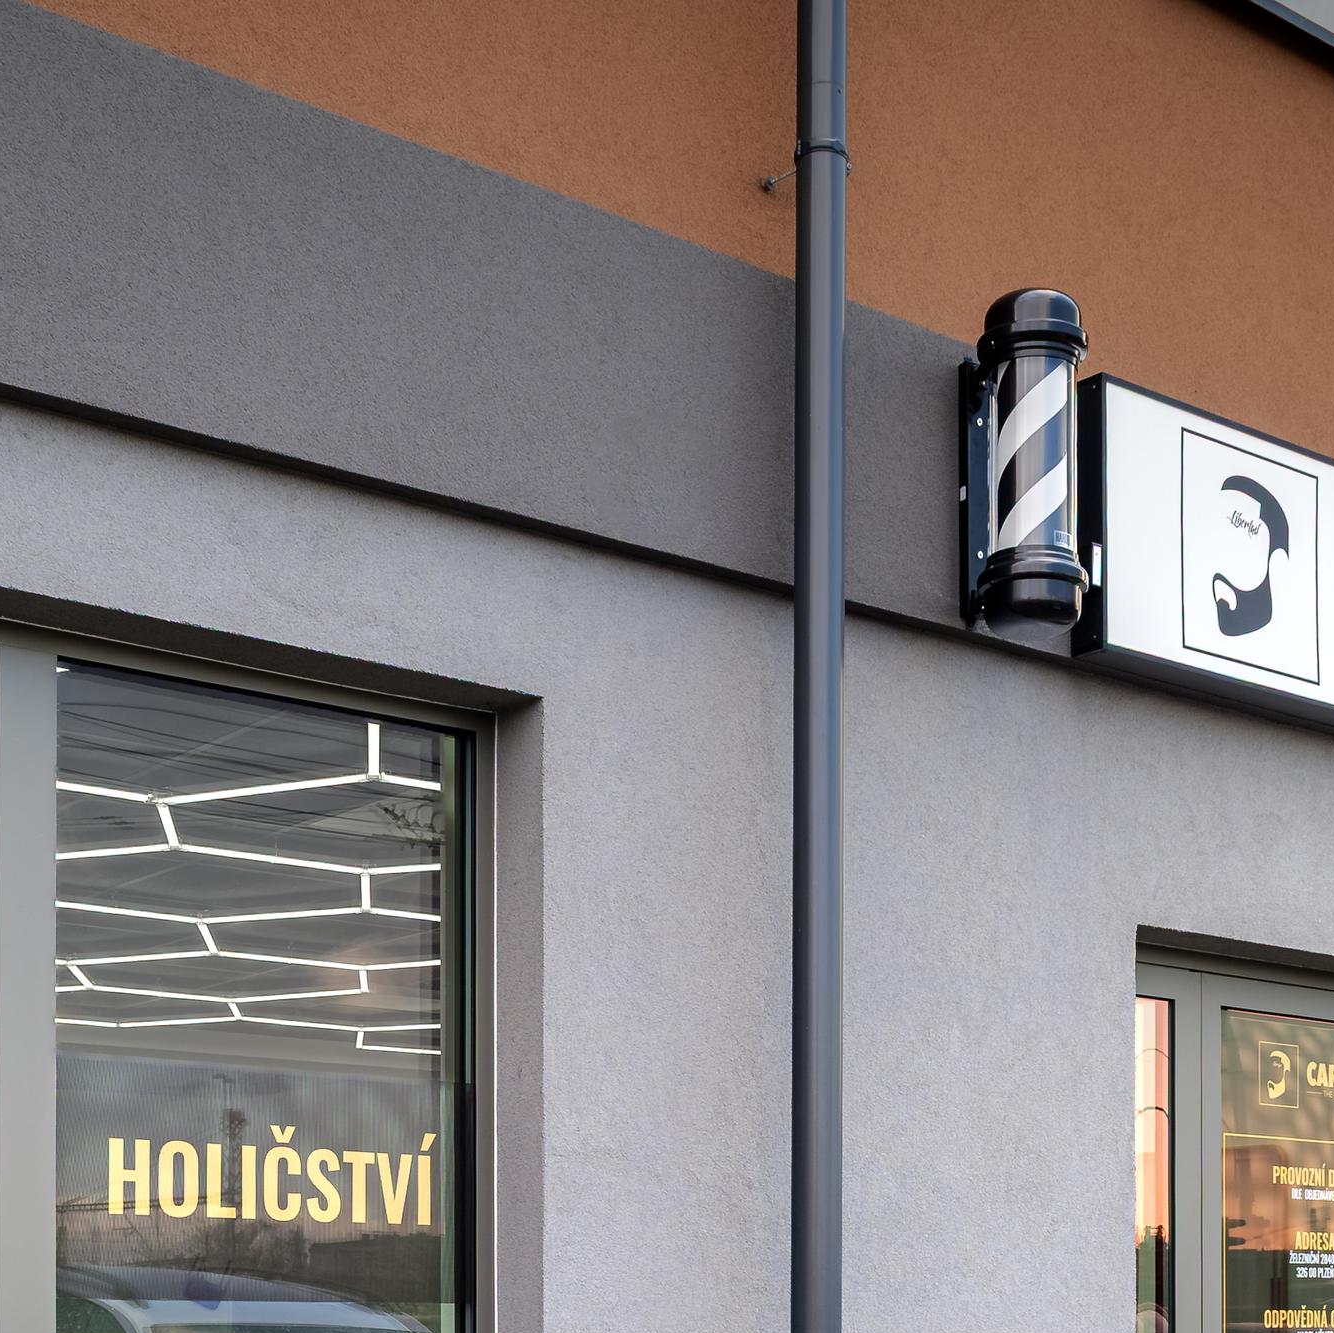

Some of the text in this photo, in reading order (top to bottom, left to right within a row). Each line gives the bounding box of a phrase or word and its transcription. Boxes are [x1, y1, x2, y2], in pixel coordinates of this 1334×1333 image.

[108, 1124, 437, 1226] HOLIČSTVÍ
[1272, 1163, 1326, 1187] PROVOZNÍ
[1291, 1188, 1302, 1200] DLE
[1296, 1265, 1334, 1279] 326 00 PLZEŇ
[1264, 1305, 1328, 1329] ODPOVĚDNÁ
